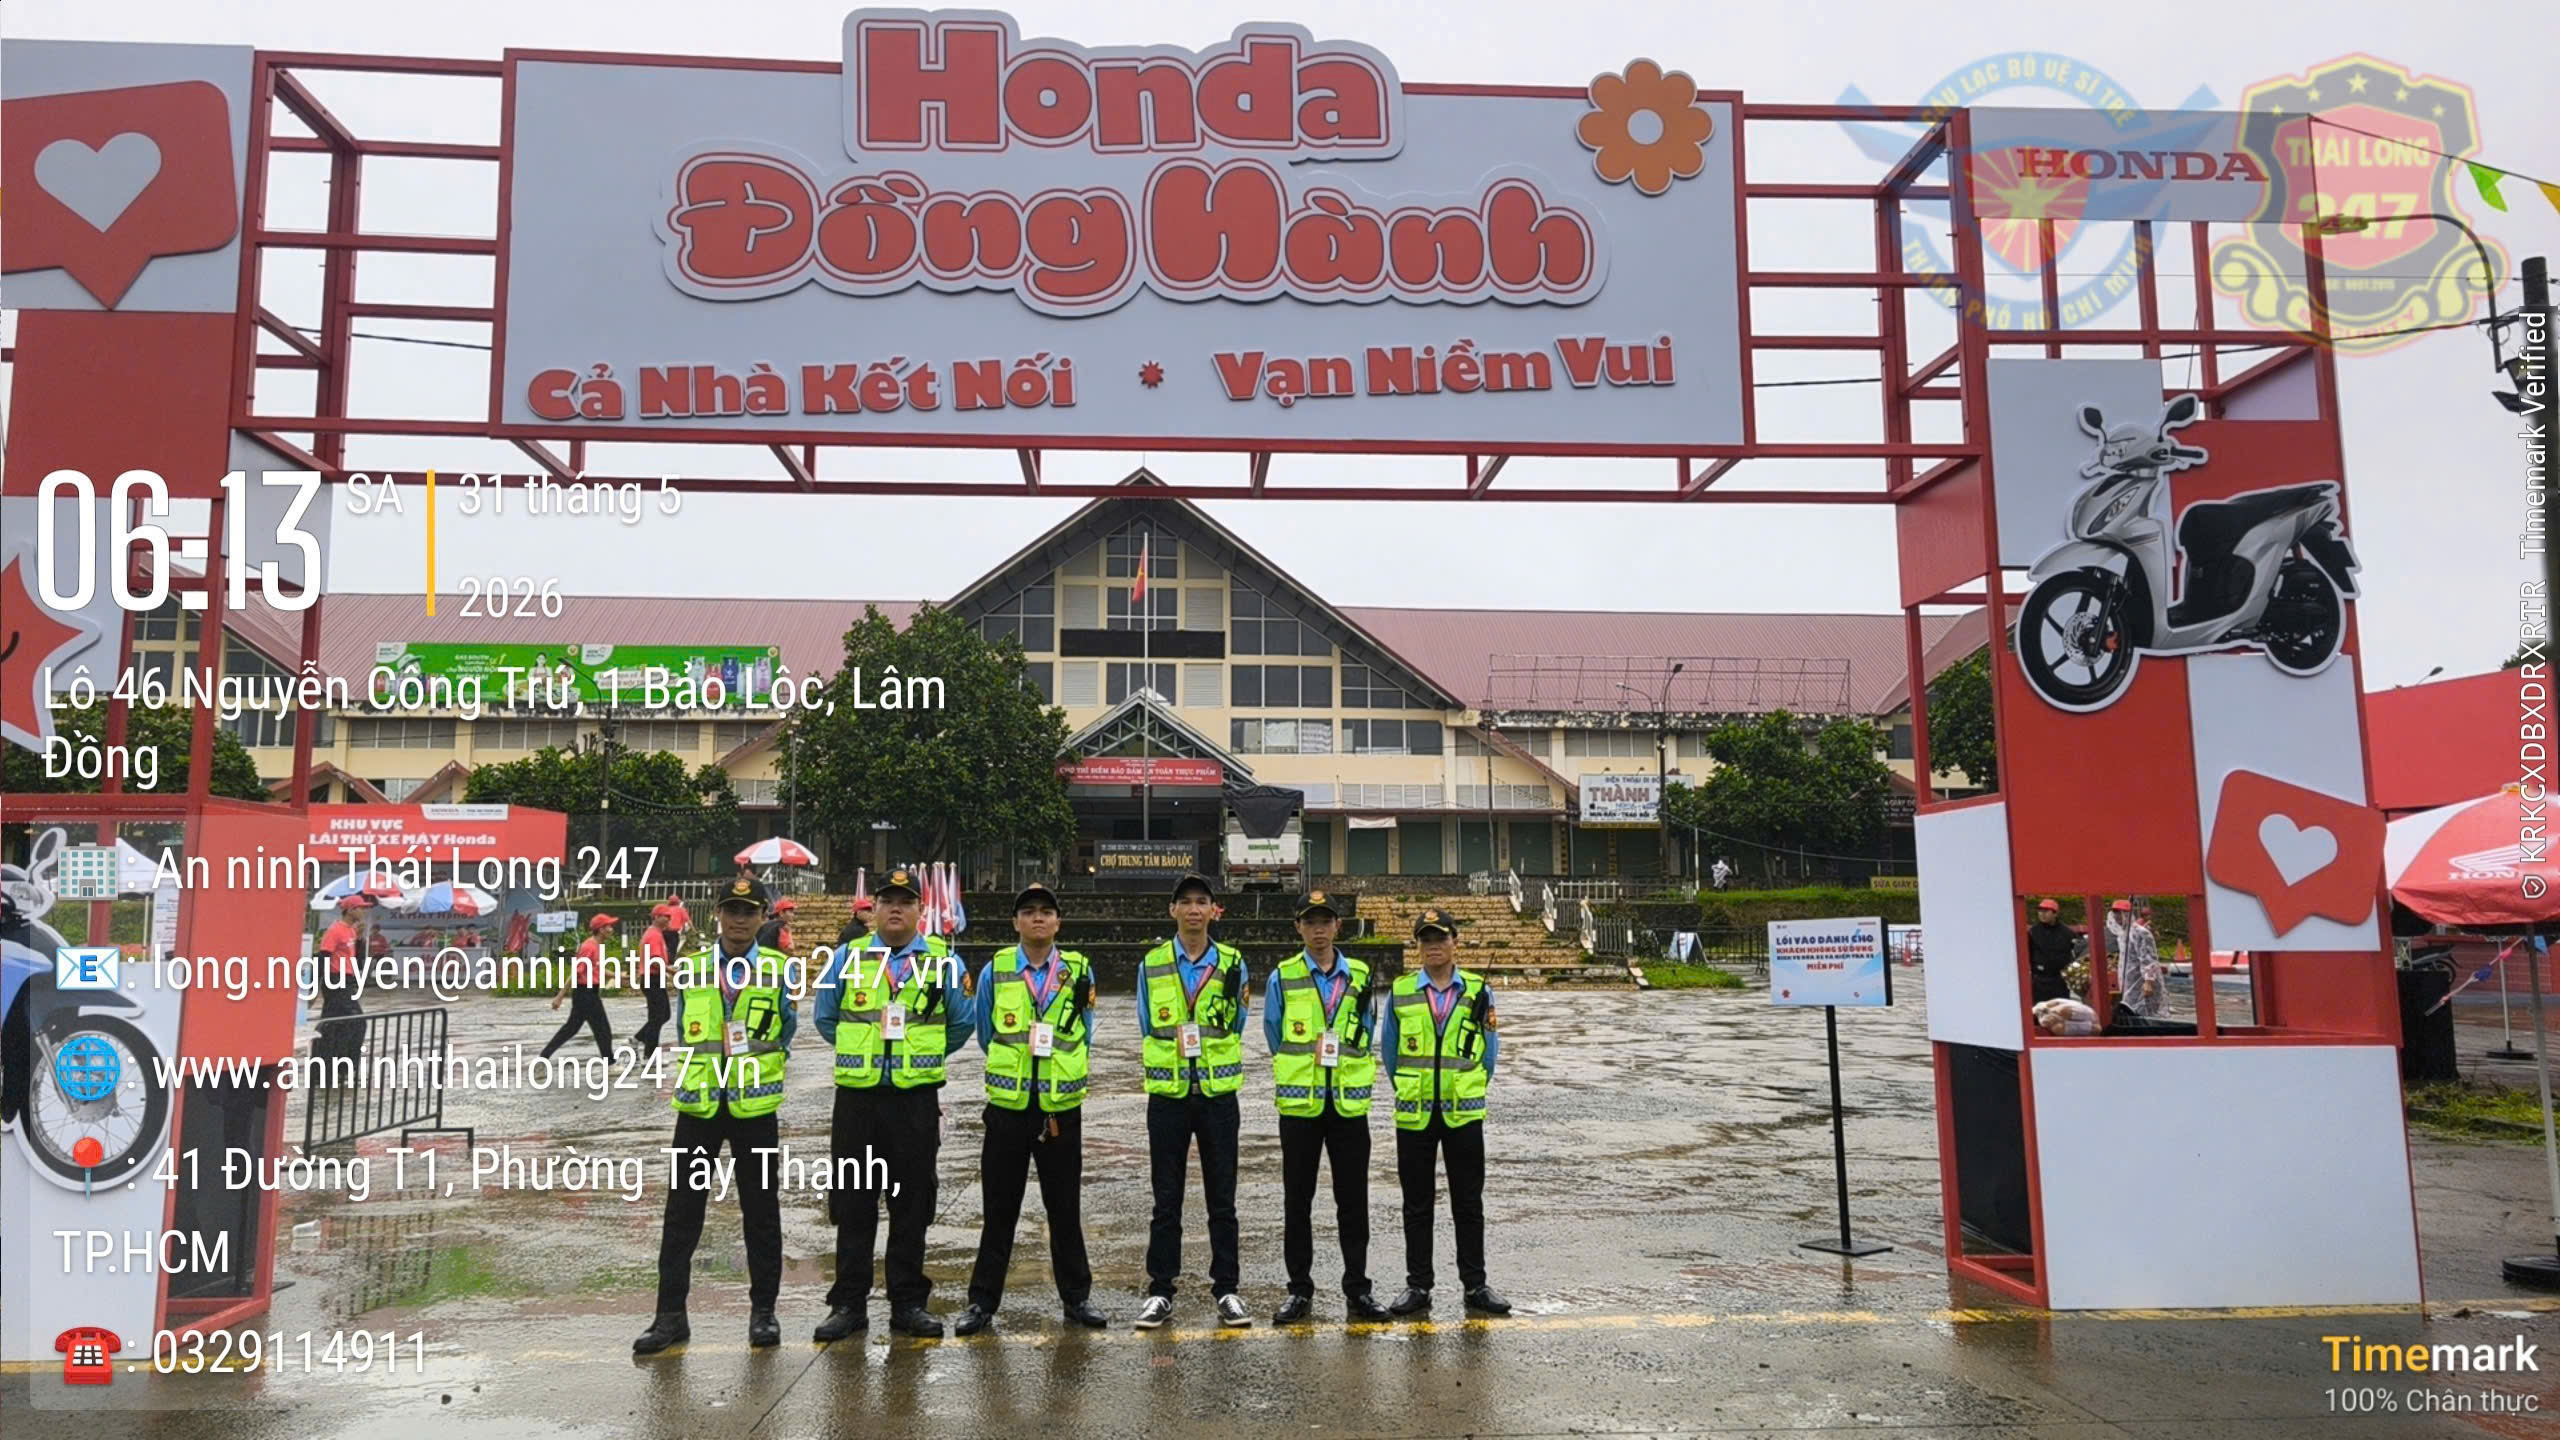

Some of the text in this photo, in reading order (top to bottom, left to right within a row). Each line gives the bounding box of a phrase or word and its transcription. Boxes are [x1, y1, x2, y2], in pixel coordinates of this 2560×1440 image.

[857, 18, 1392, 151] Honda
[2018, 148, 2270, 183] HONDA
[667, 153, 1601, 305] Đồng Hành
[527, 352, 1077, 420] Cả Nhà Kết Nối
[1213, 334, 1675, 408] Vạn Niềm Vui
[1588, 784, 1650, 802] THÀNH
[309, 831, 338, 845] LÁI
[378, 834, 400, 845] XE
[402, 831, 441, 845] MÁY
[443, 833, 497, 846] Honda
[330, 818, 403, 832] KHU VỰC
[1118, 854, 1142, 867] TRUNG
